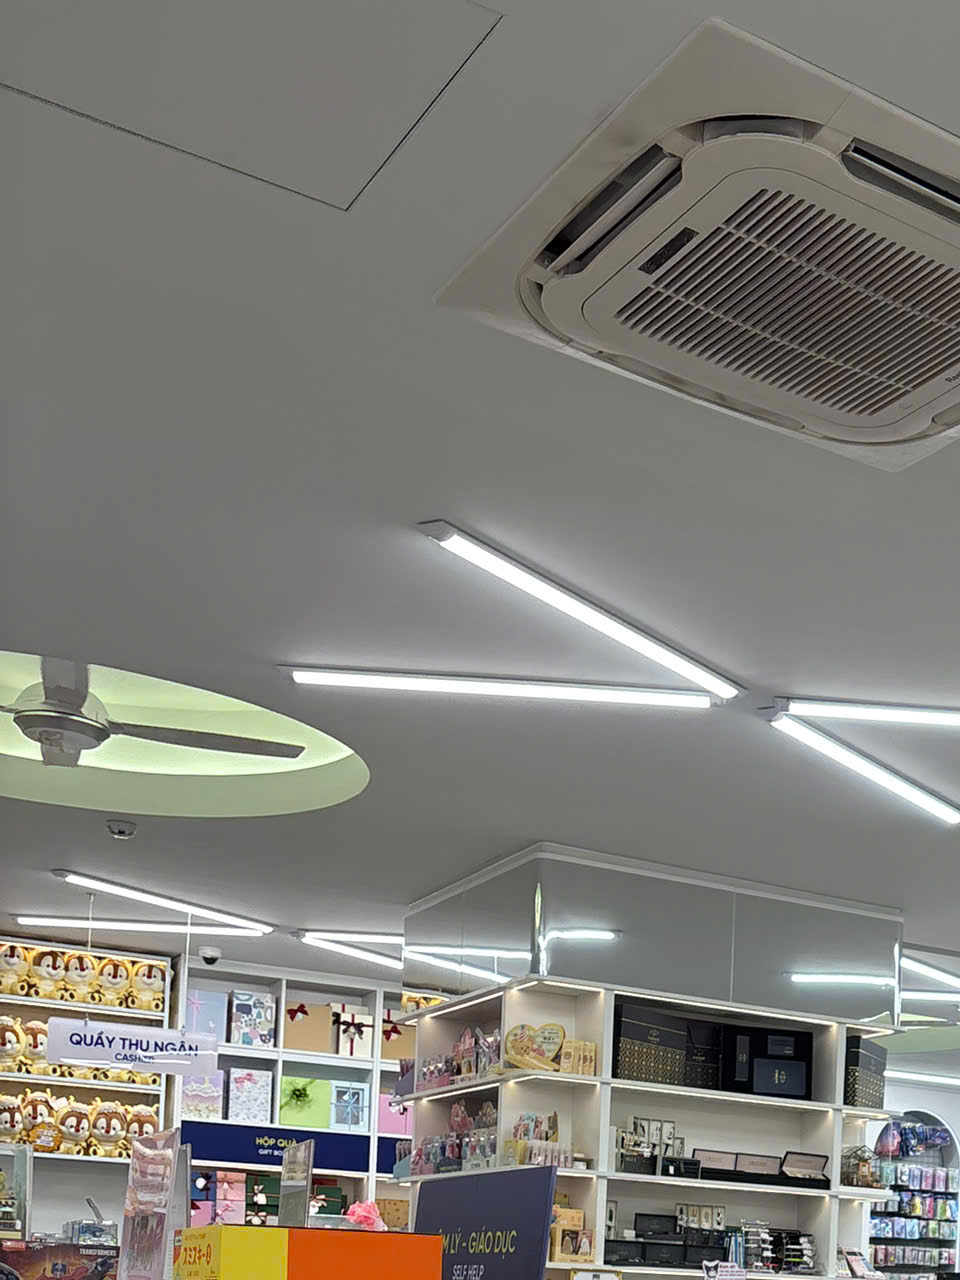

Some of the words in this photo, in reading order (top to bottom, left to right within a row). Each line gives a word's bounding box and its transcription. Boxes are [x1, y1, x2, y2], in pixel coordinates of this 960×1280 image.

[119, 1036, 150, 1052] THU
[154, 1040, 199, 1057] NGÂN
[256, 1136, 275, 1149] HỘP
[468, 1226, 493, 1254] GIÁO
[495, 1230, 517, 1259] DỤC
[79, 1247, 117, 1257] TRANSFORMERS
[452, 1265, 467, 1280] SELF
[468, 1264, 485, 1280] HELP
